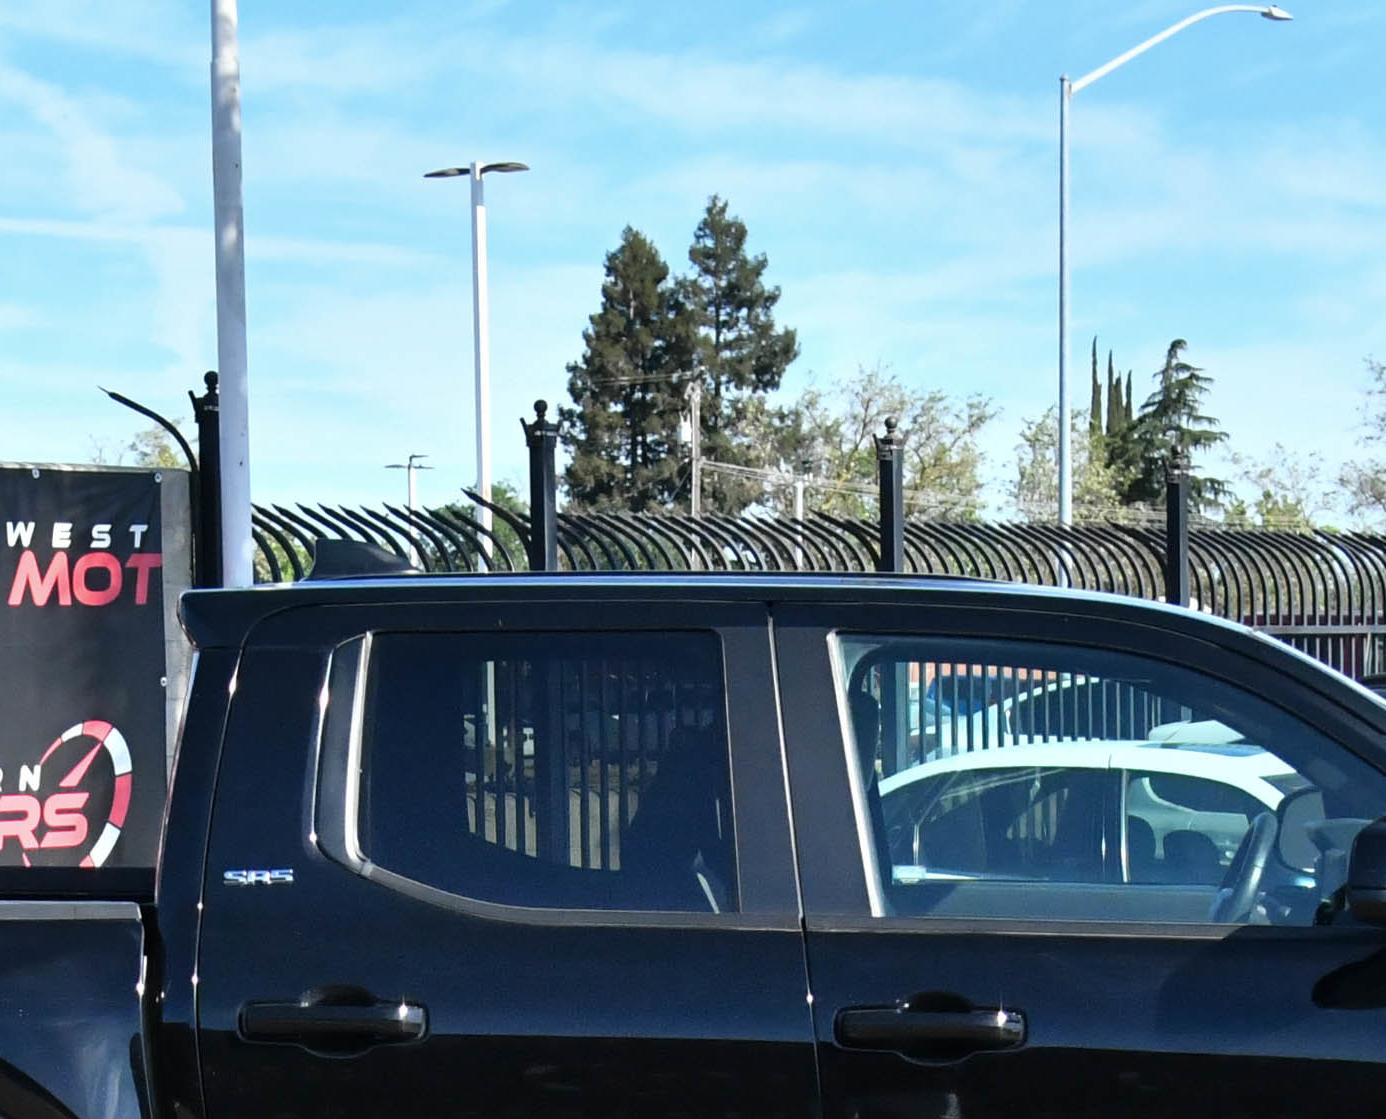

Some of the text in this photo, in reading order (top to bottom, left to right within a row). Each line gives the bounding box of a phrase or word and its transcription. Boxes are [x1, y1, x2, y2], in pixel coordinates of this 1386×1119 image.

[6, 521, 148, 548] WEST
[8, 550, 162, 607] MOT
[224, 869, 294, 885] SR5
